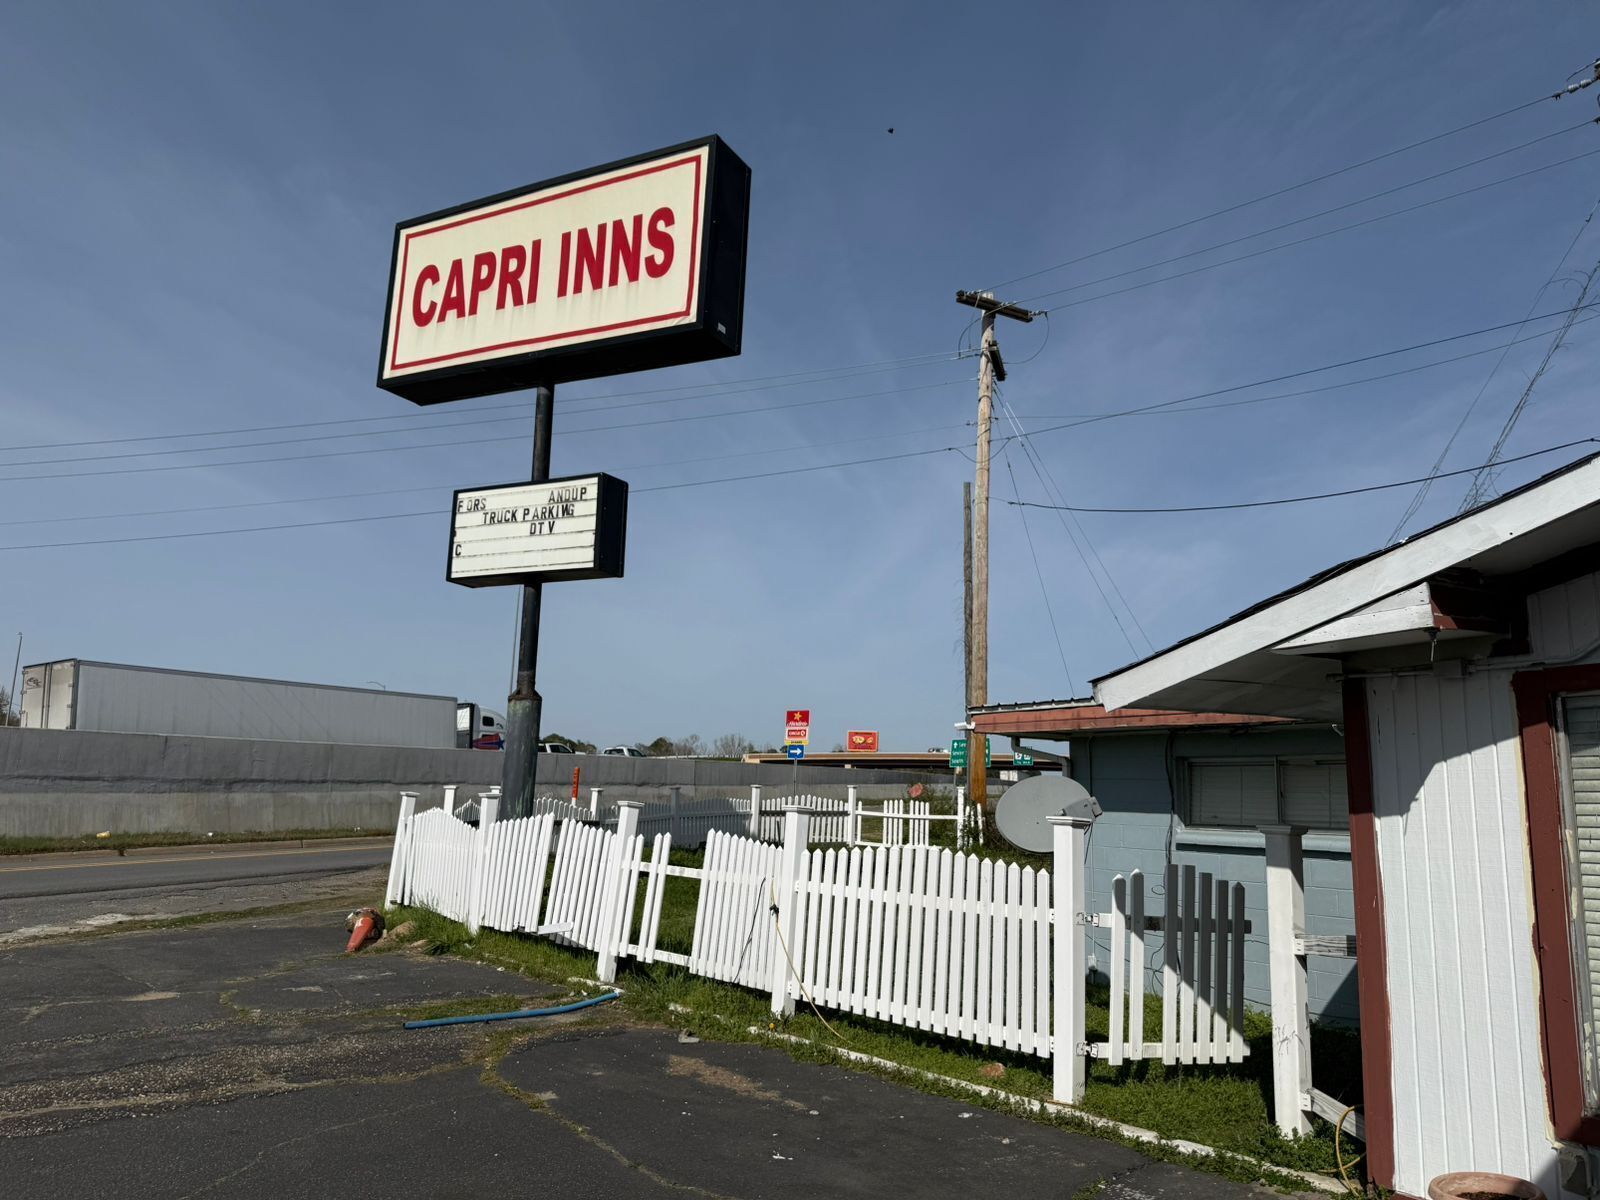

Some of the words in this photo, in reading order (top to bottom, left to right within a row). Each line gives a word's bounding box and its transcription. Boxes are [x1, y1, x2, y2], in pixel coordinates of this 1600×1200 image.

[412, 238, 542, 328] CAPRI
[556, 206, 676, 298] INNS
[483, 509, 518, 524] TRUCK
[523, 503, 575, 520] PARKING
[455, 544, 462, 556] C
